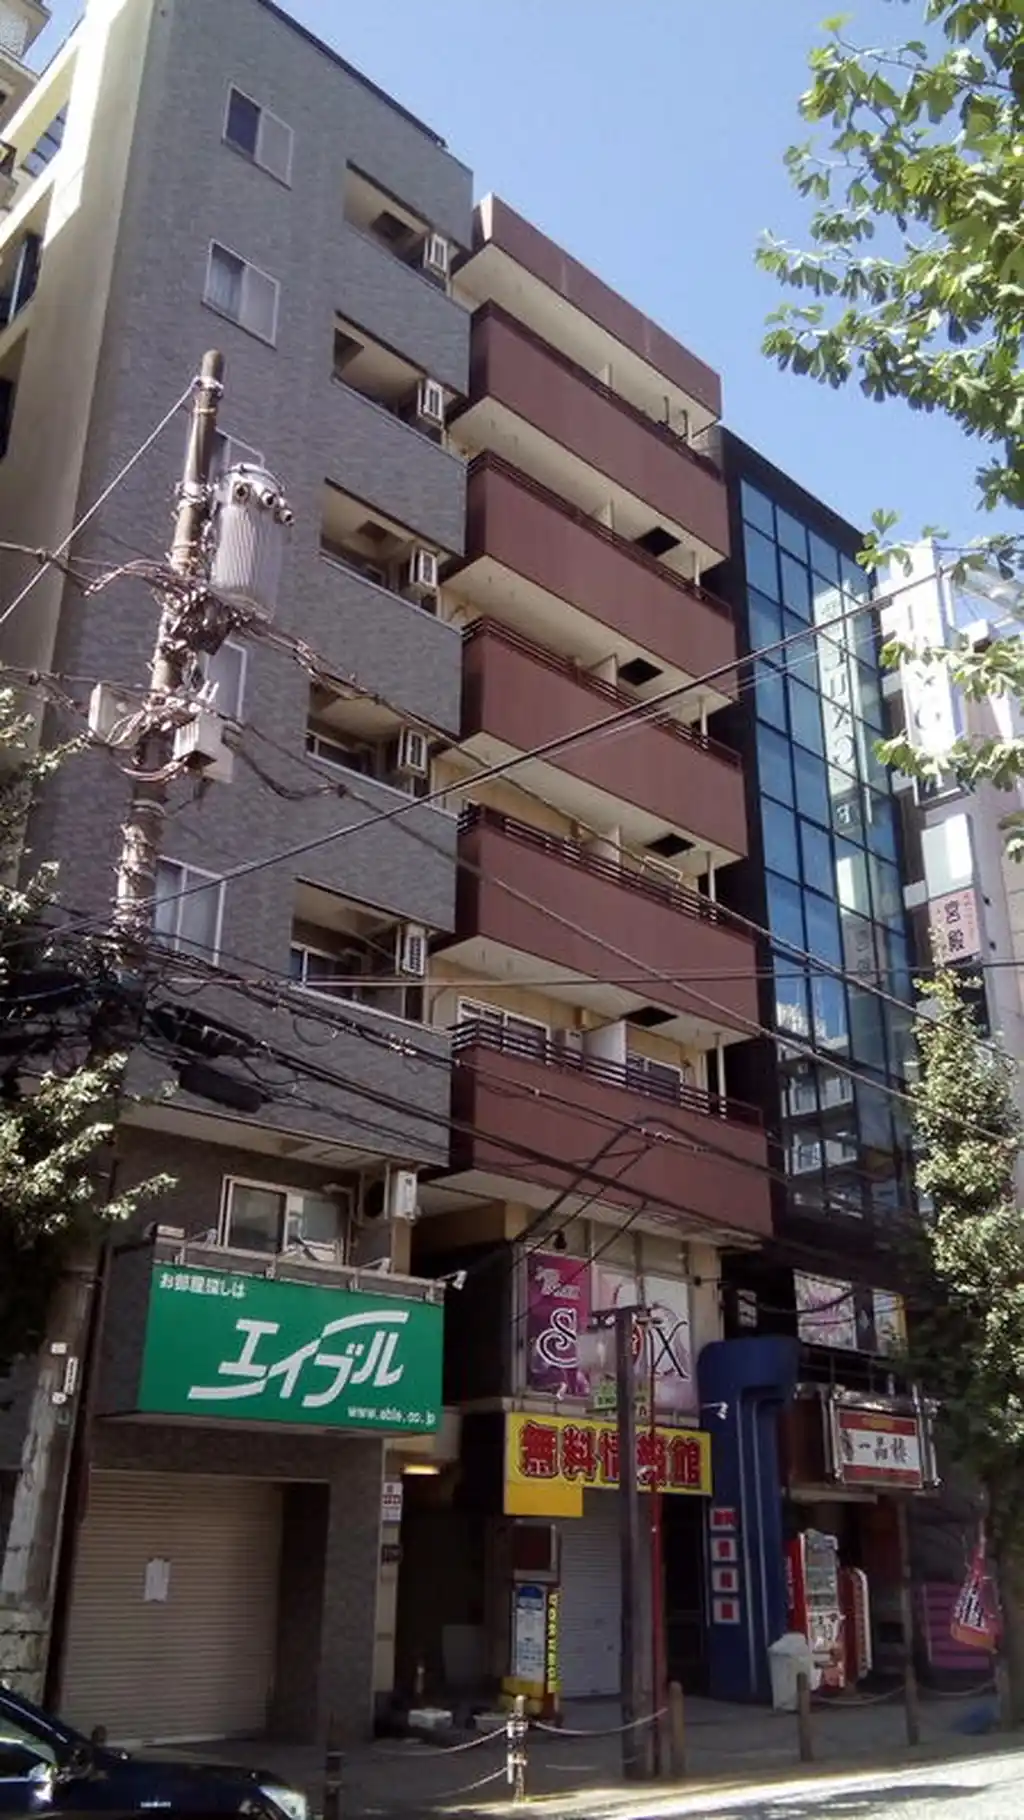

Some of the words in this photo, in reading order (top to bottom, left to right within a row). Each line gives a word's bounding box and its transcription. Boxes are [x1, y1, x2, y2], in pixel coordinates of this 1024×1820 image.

[159, 1272, 246, 1299] お部屋探しは
[188, 1310, 410, 1408] エイブル
[348, 1405, 436, 1426] www.able.co.jp
